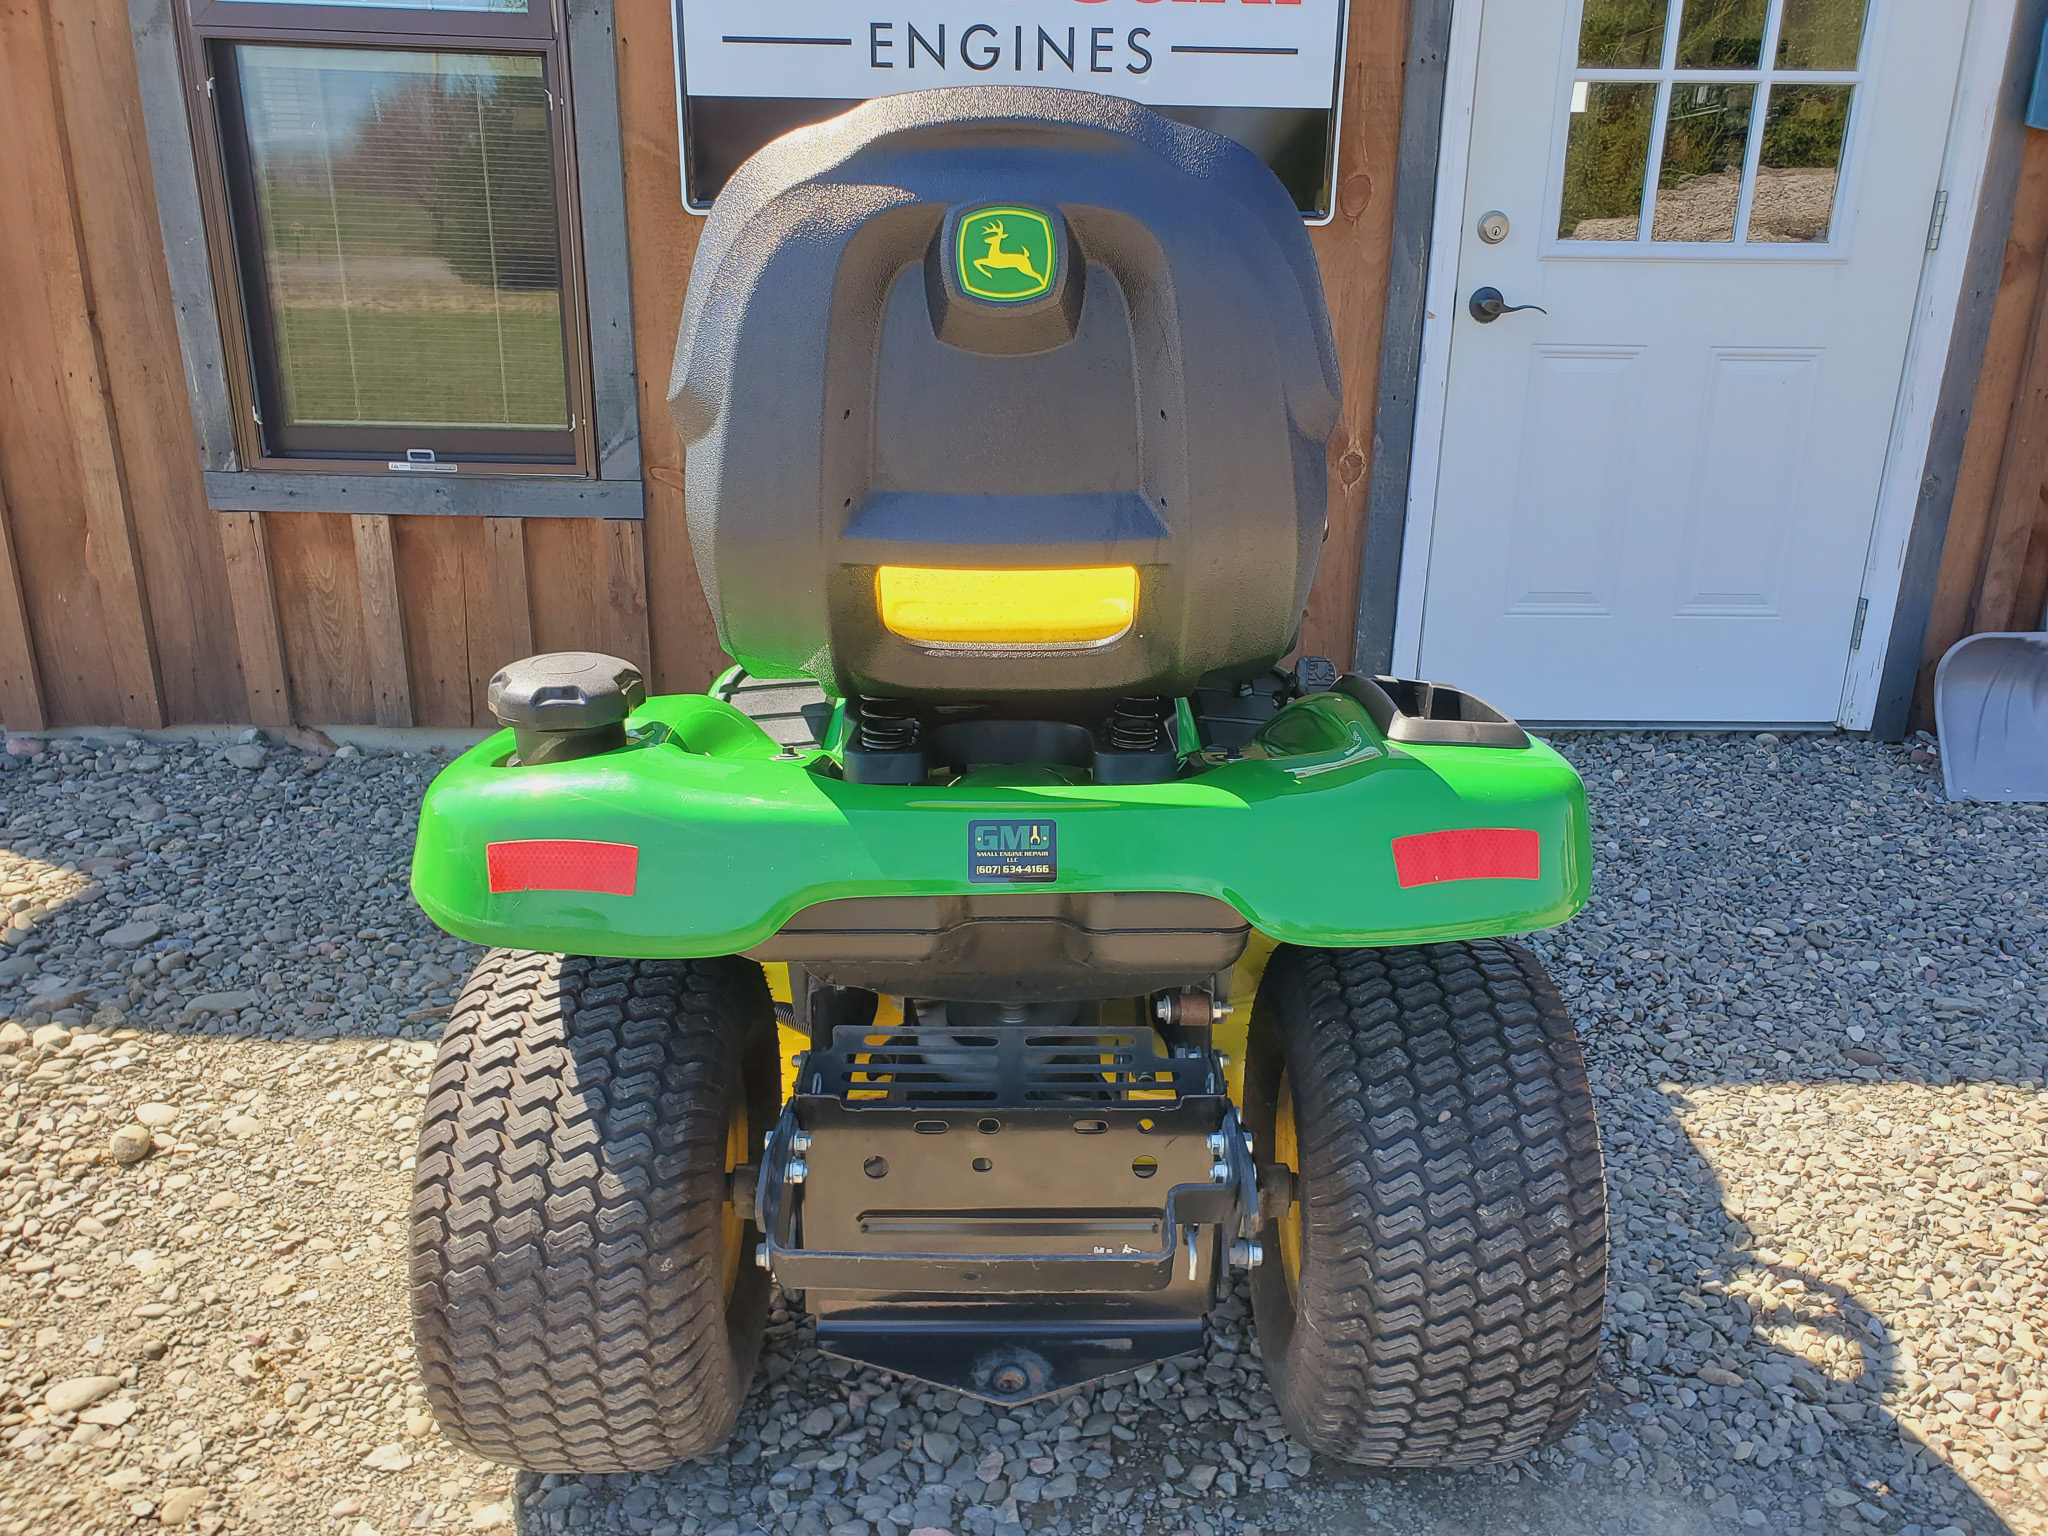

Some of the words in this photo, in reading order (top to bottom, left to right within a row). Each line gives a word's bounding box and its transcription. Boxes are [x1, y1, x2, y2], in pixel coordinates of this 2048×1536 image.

[869, 22, 1153, 74] ENGINES
[976, 865, 1001, 875] (607)
[1002, 864, 1050, 874] 634-4166
